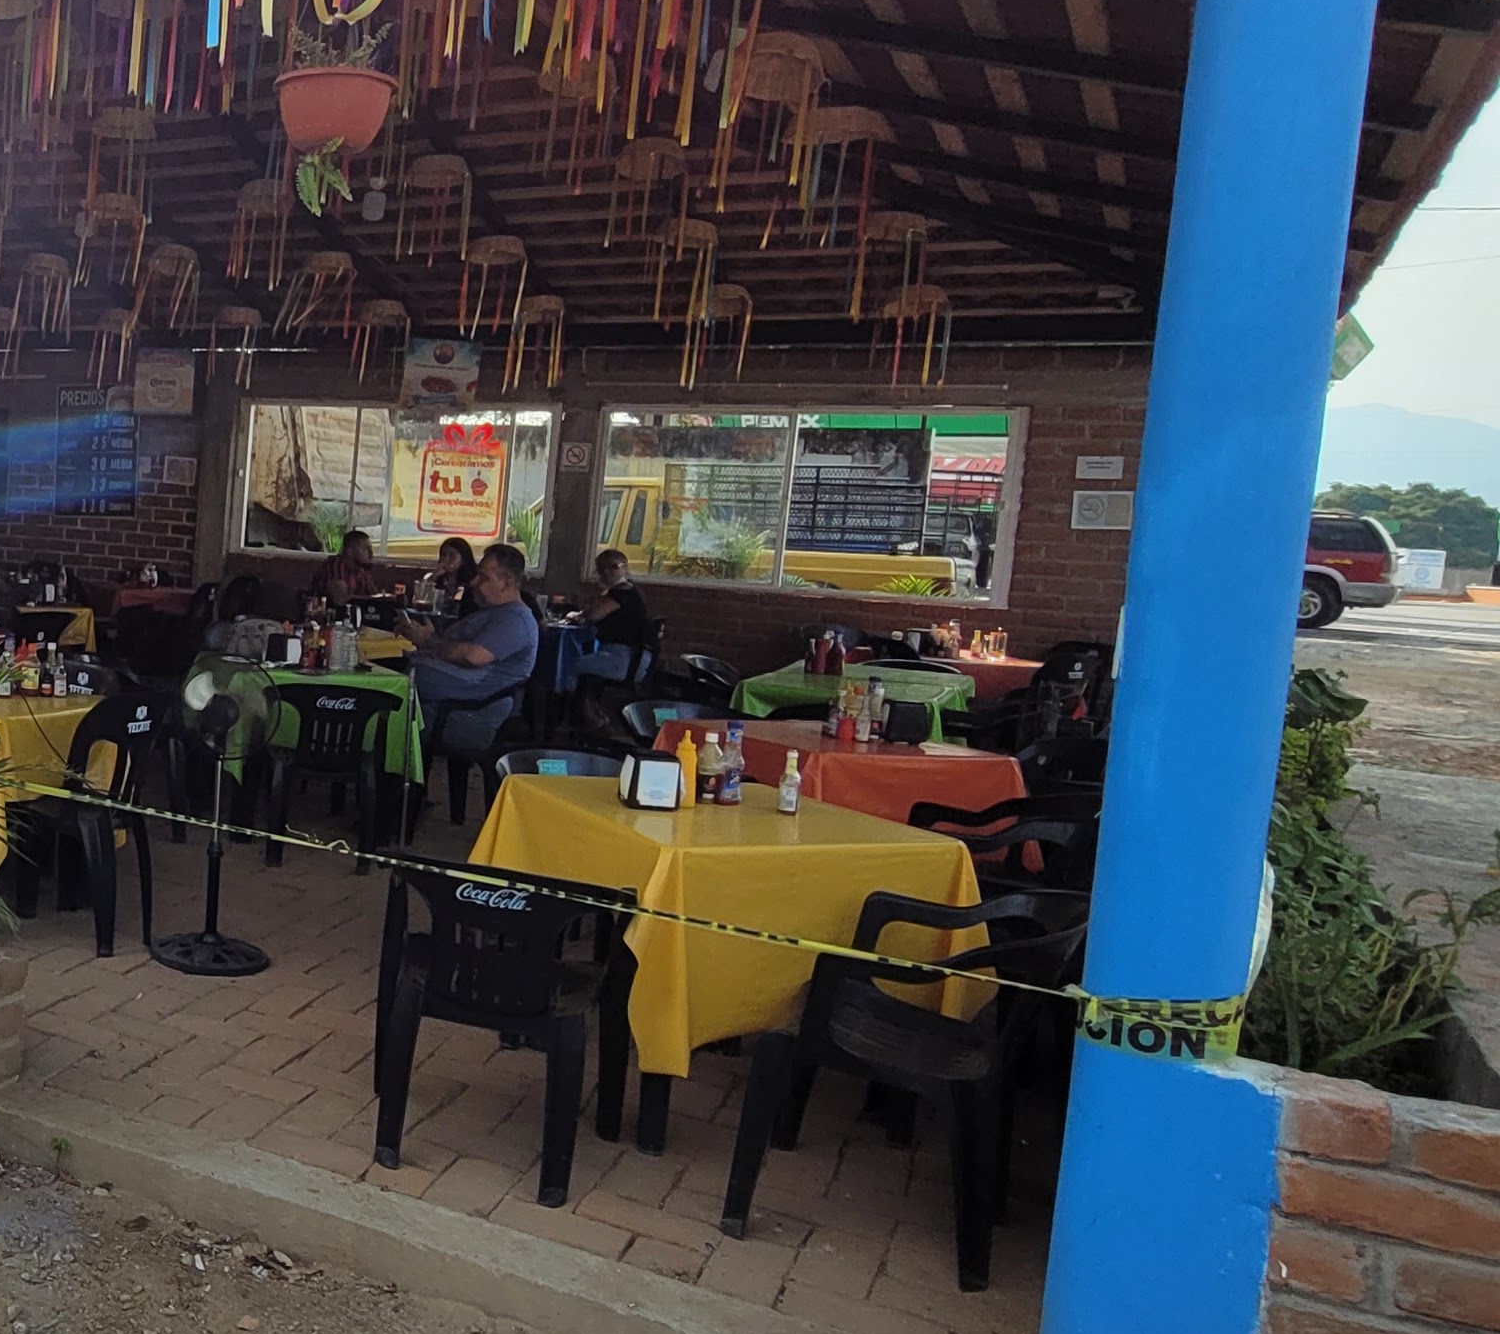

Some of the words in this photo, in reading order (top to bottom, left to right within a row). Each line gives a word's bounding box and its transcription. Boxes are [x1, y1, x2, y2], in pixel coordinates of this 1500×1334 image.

[60, 389, 105, 406] PRECIOS
[429, 470, 462, 494] tu
[127, 720, 152, 734] TECATE
[456, 882, 530, 910] Coca-Cola
